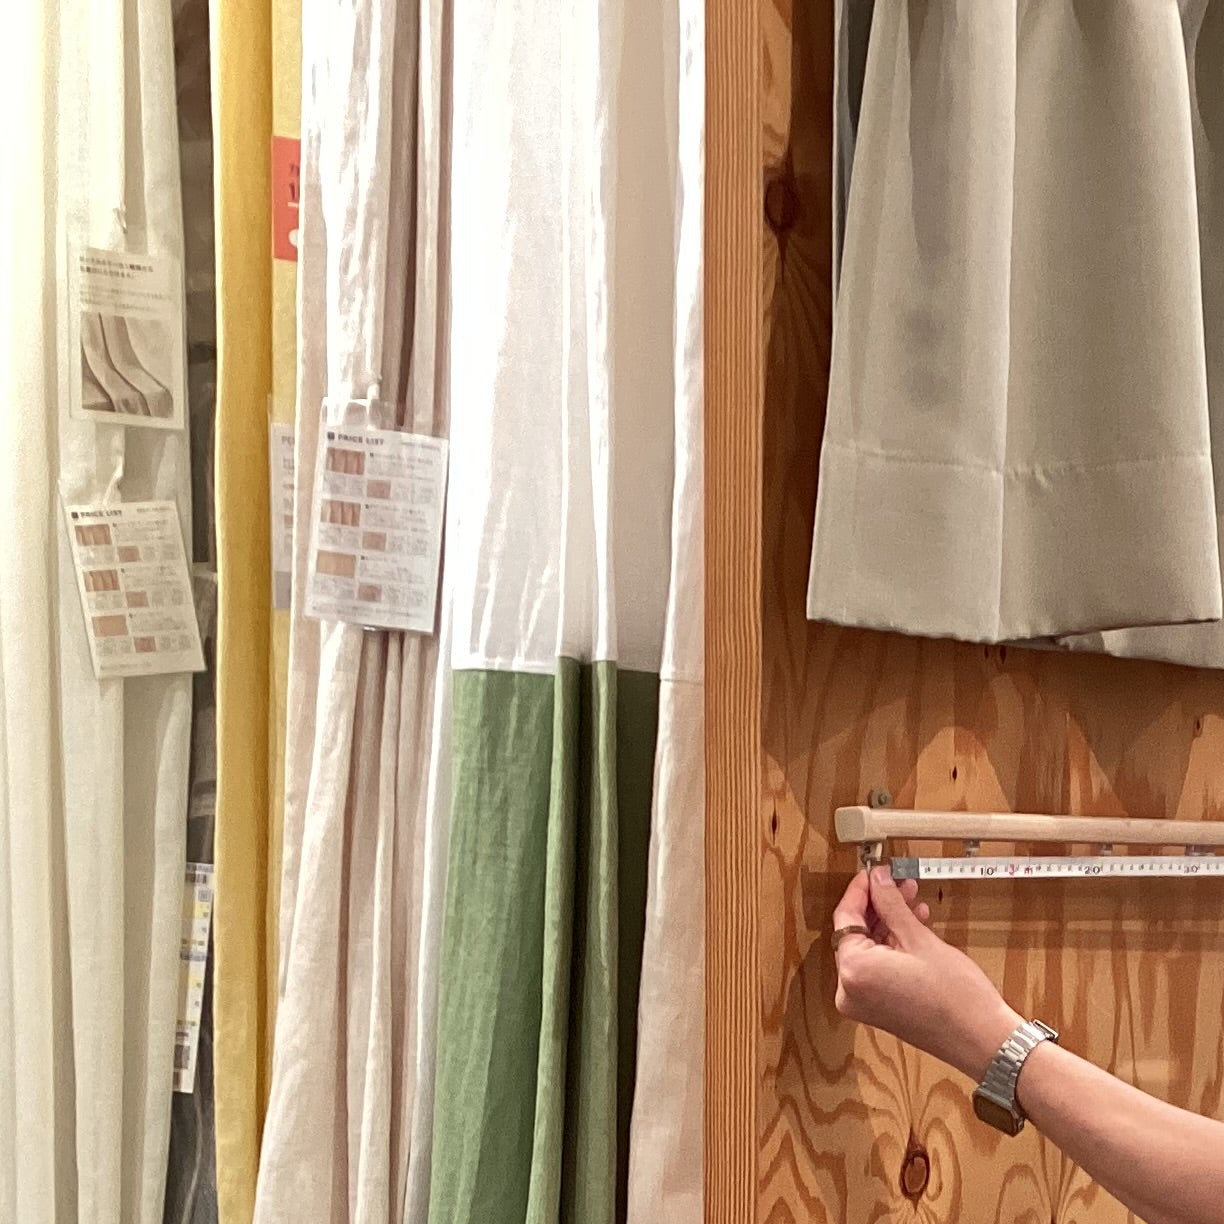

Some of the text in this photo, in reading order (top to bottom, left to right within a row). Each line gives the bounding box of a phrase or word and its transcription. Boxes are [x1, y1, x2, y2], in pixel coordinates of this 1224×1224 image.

[338, 433, 385, 446] PRICE LIST
[106, 509, 122, 517] LIST
[980, 866, 995, 876] 10
[1084, 865, 1101, 875] 20
